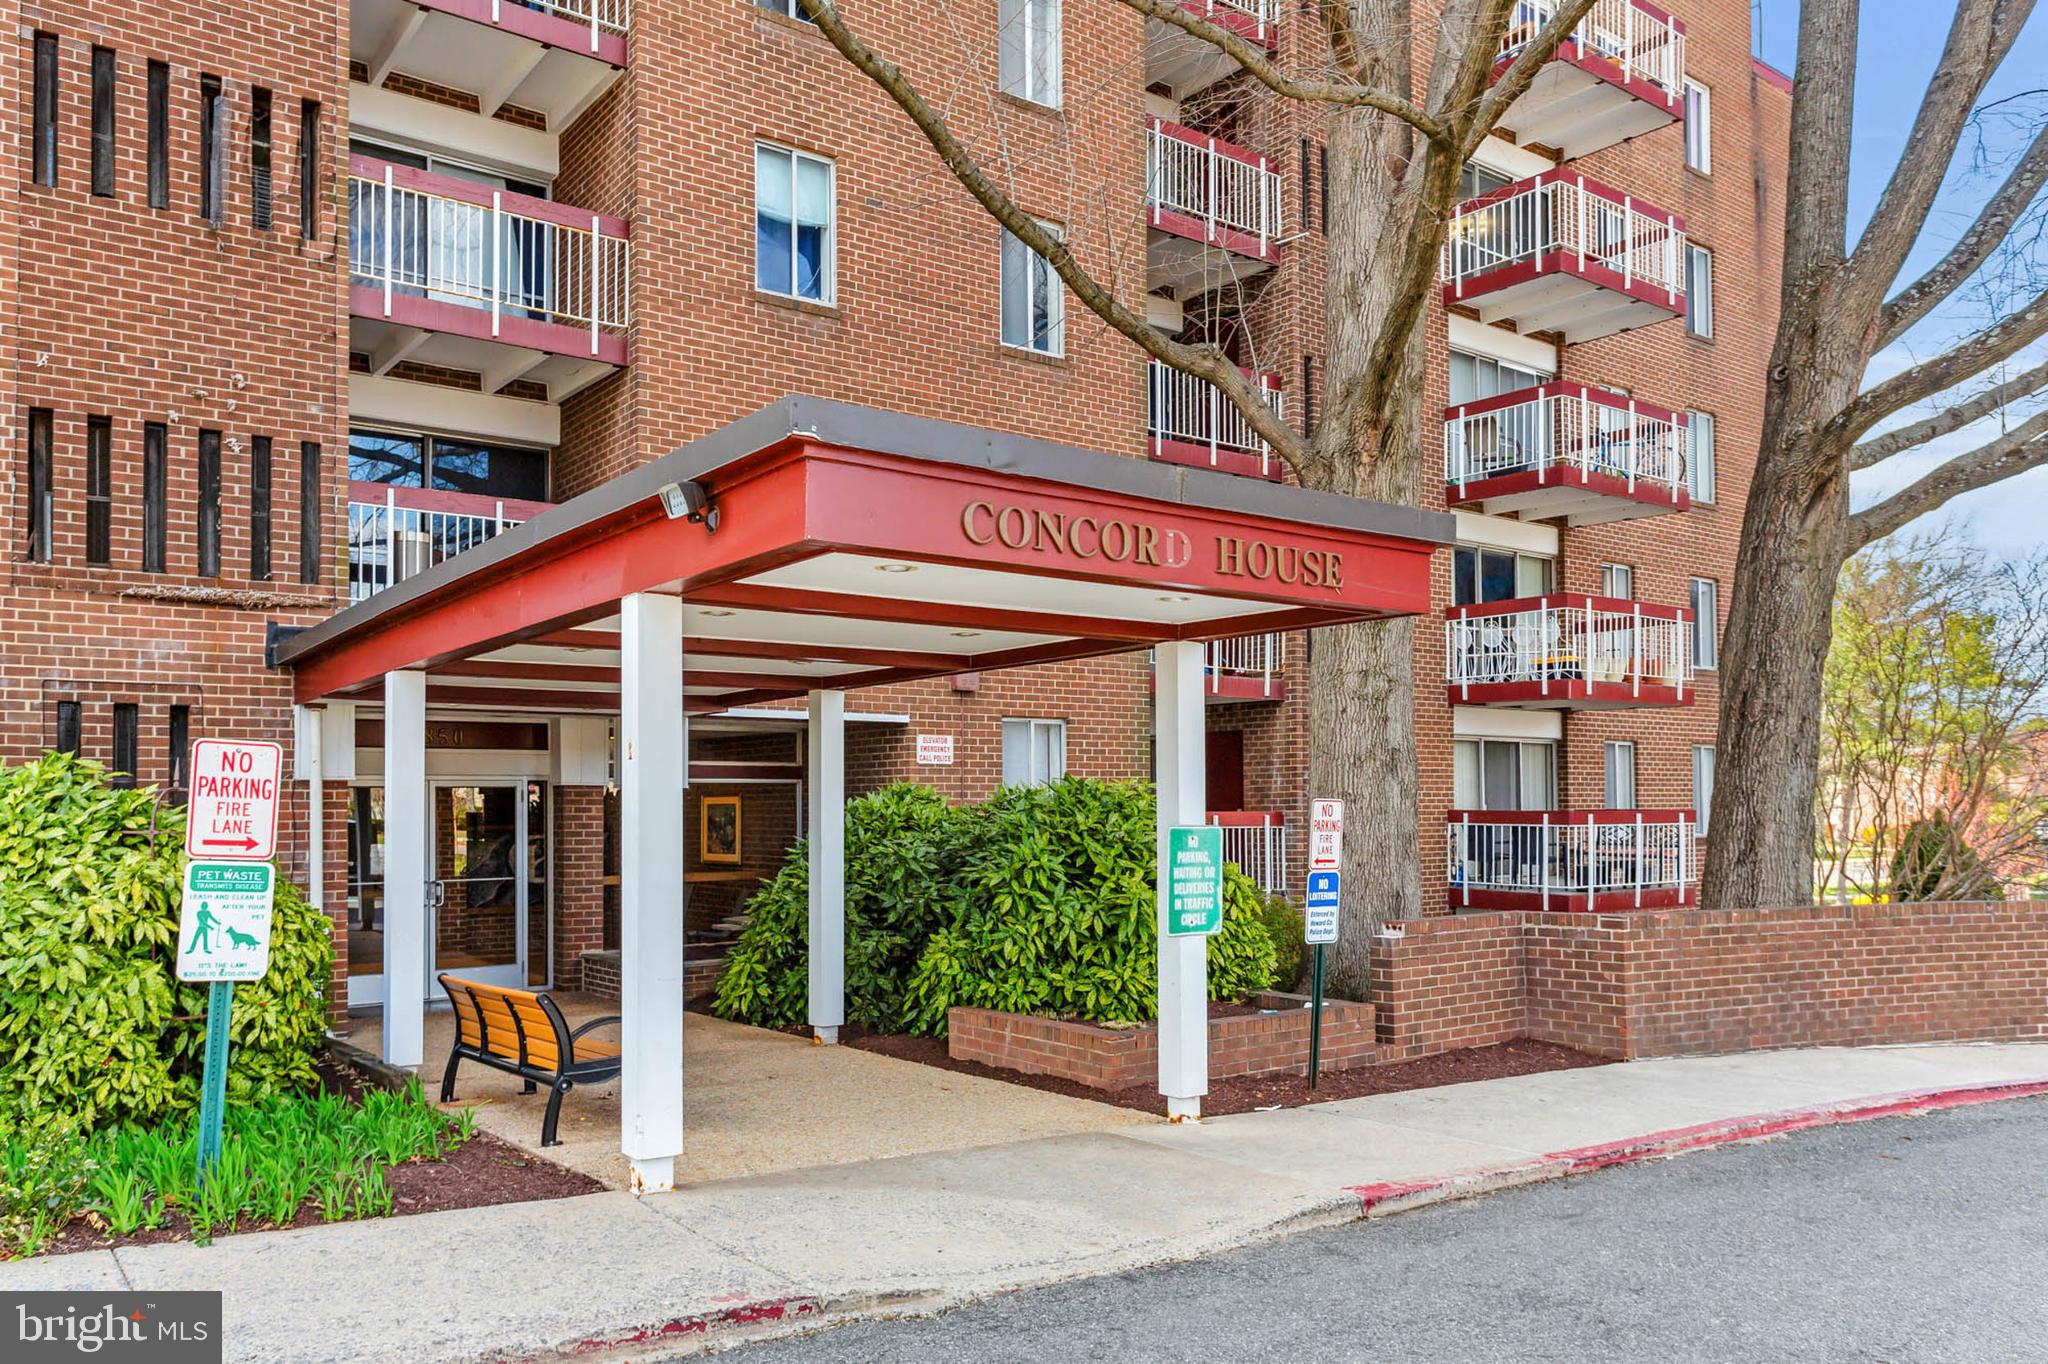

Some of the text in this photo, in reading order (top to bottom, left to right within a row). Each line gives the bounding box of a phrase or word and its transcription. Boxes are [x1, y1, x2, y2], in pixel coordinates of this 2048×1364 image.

[962, 501, 1344, 588] CONCORD HOUSE
[221, 751, 253, 773] NO
[198, 776, 272, 800] PARKING
[217, 802, 251, 816] FIRE
[1321, 803, 1333, 818] NO
[212, 819, 252, 834] LANE
[1314, 819, 1341, 832] PARKING
[1188, 836, 1199, 848] NO
[1319, 834, 1333, 843] FIRE
[1317, 845, 1333, 855] LANE
[198, 870, 262, 881] PET WASTE
[1173, 866, 1216, 880] WAITING OR
[1174, 882, 1214, 895] DELIVERIES
[1318, 878, 1329, 890] NO
[1309, 891, 1337, 901] LOITERING
[1174, 897, 1214, 911] IN TRAFFIC
[1181, 912, 1208, 926] CIRCLE
